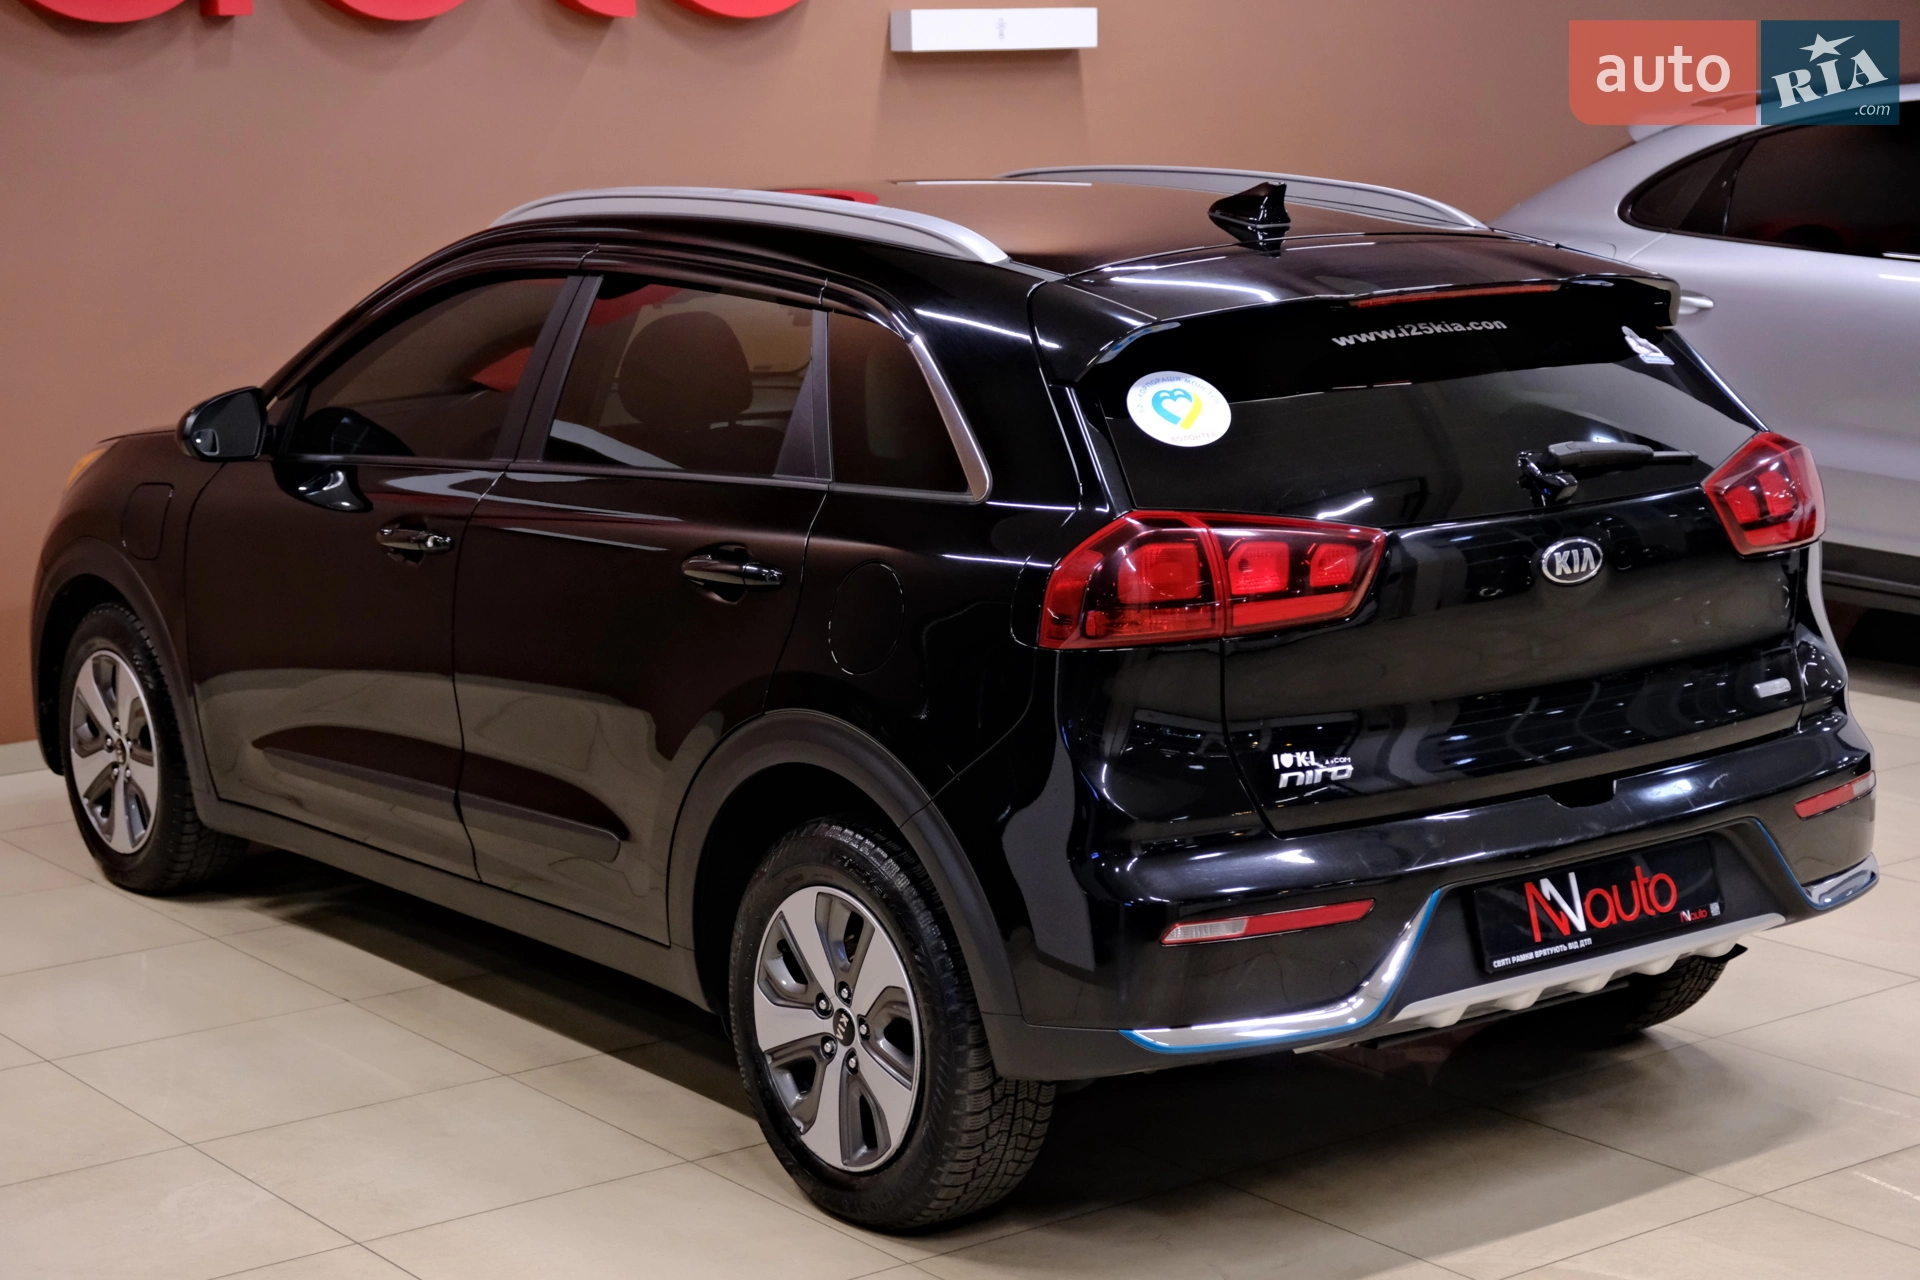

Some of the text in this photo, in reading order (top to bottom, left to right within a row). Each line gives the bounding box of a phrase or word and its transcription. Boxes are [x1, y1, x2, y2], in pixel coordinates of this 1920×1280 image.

[1171, 431, 1217, 443] ВОЛОНТЕР
[1554, 547, 1596, 576] KIA
[1279, 765, 1354, 788] niro
[1493, 938, 1592, 968] СВЯТІ РАМКИ ВРЯТУЮТЬ ВІД ДТП
[836, 1014, 849, 1040] KIA
